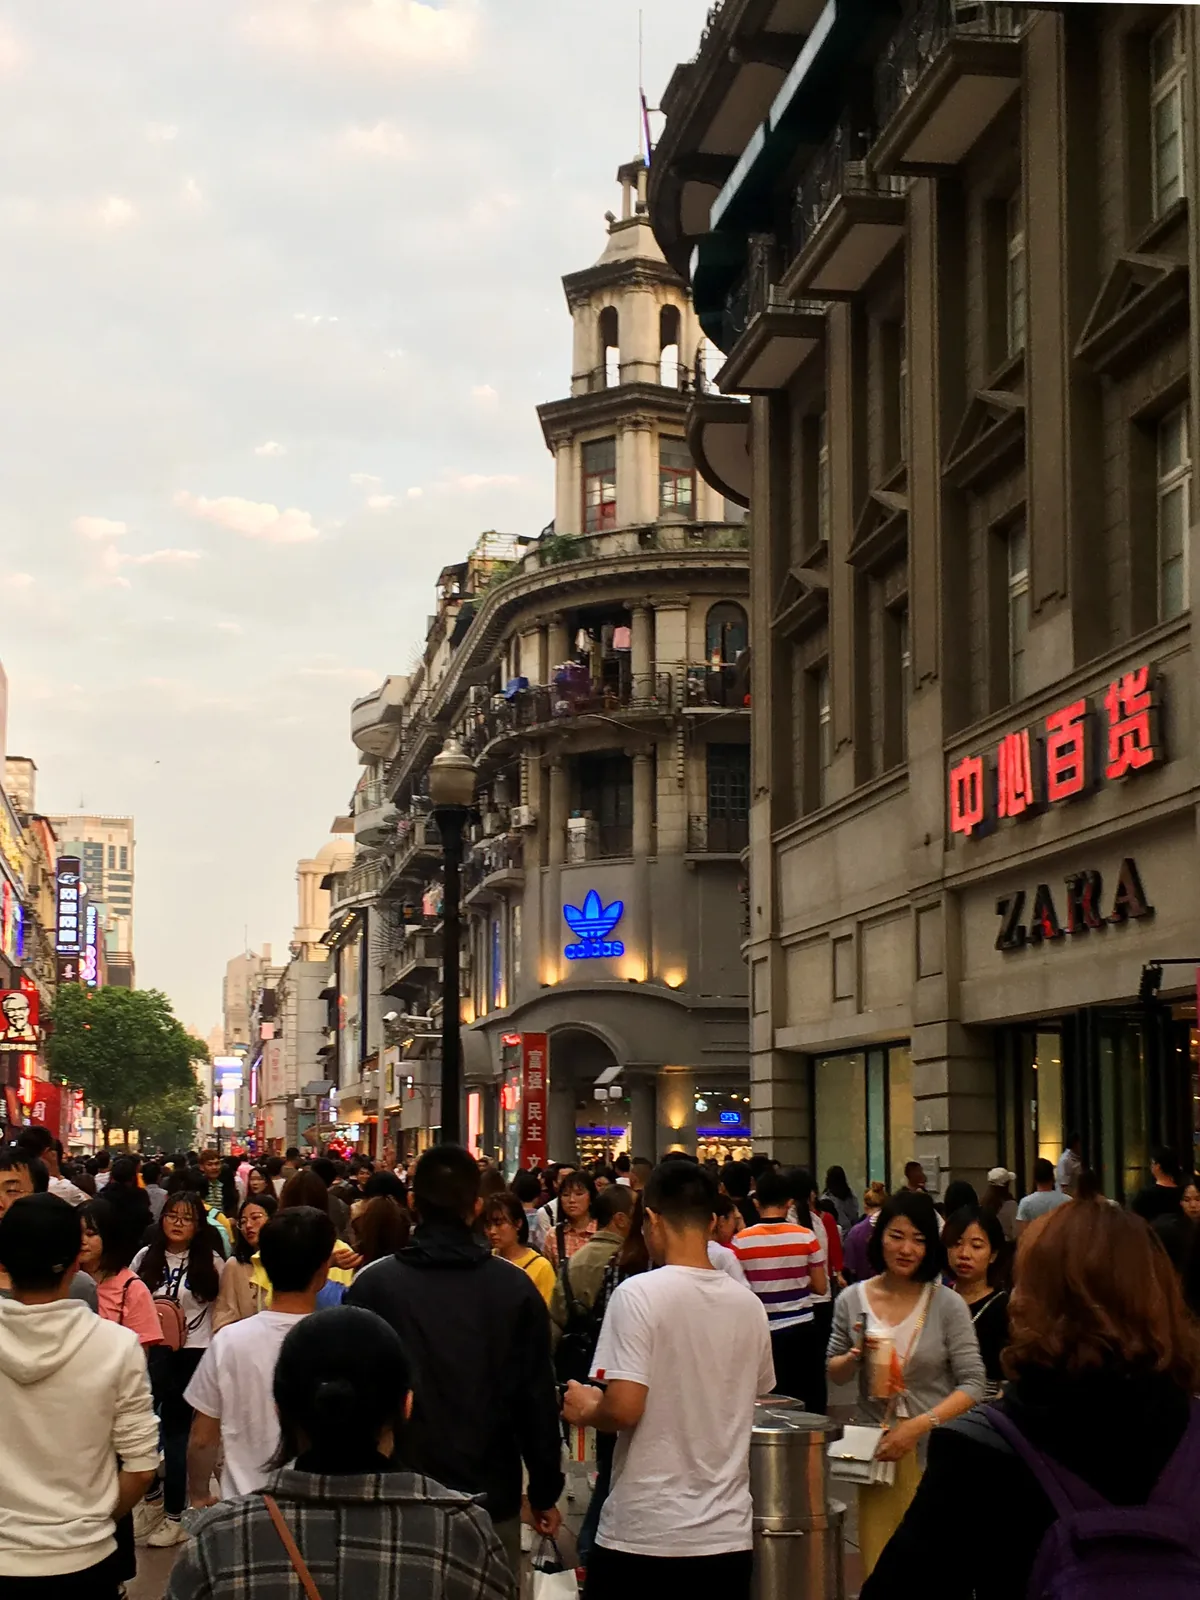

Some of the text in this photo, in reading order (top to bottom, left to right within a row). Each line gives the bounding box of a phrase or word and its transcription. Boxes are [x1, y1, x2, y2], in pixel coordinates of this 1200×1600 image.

[951, 665, 1154, 835] 中心百货
[995, 858, 1155, 950] ZARA
[527, 1050, 543, 1171] 富强 民主 文
